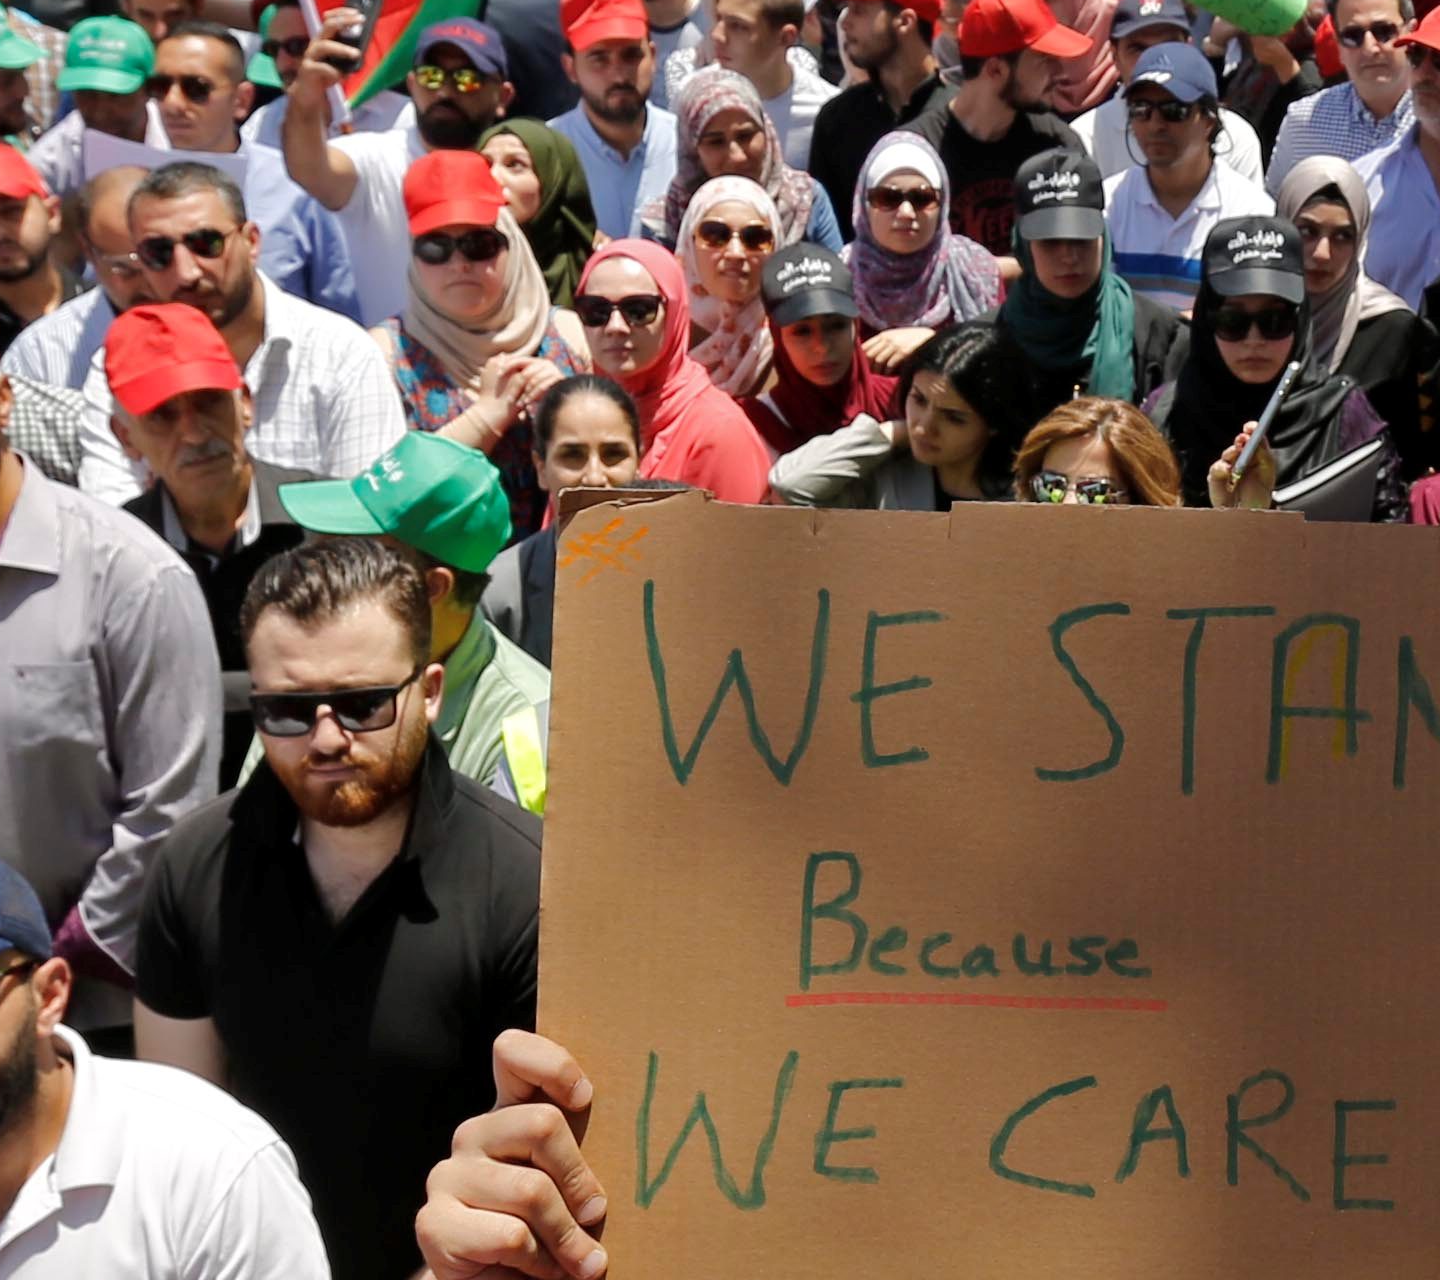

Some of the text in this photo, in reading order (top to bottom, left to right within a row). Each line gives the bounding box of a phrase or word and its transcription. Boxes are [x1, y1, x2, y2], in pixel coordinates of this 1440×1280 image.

[641, 578, 948, 787] WE
[798, 850, 1154, 990] Because
[635, 1049, 905, 1211] WE
